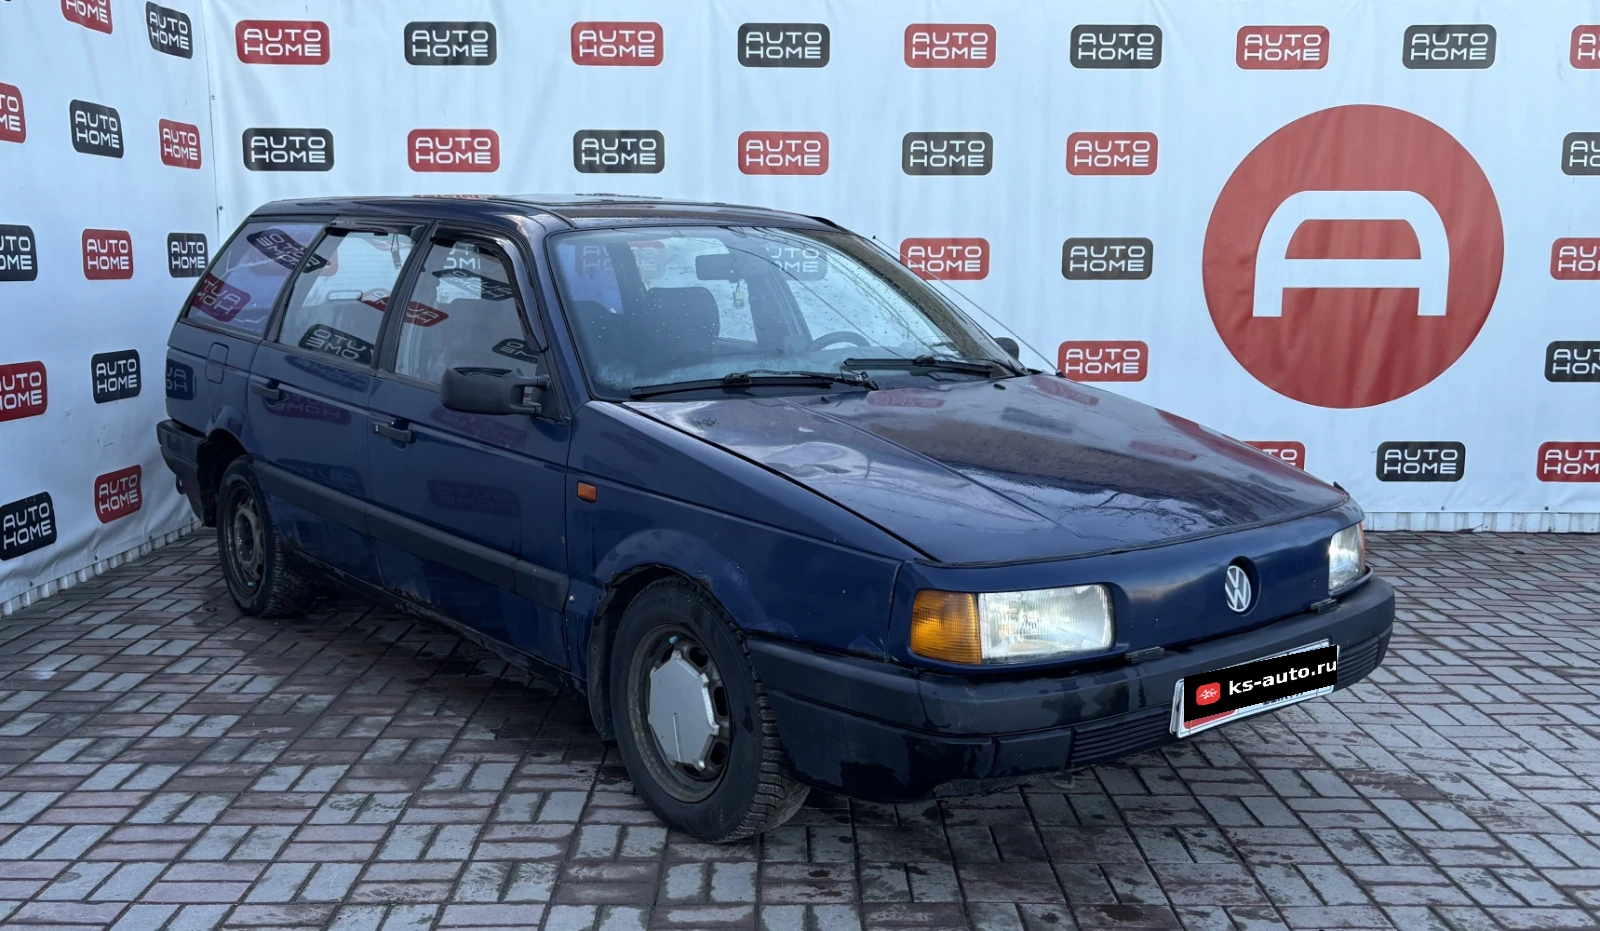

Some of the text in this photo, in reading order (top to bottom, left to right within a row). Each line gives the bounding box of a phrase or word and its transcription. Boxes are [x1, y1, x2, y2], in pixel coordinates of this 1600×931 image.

[66, 0, 109, 23] HOME
[149, 11, 188, 34] AUTO
[151, 29, 190, 50] HOME
[244, 29, 321, 42] AUTO
[412, 30, 489, 42] AUTO
[579, 30, 656, 42] AUTO
[746, 31, 822, 44] AUTO
[912, 32, 988, 44] AUTO
[1078, 33, 1154, 45] AUTO
[1245, 34, 1322, 46] AUTO
[1412, 33, 1488, 46] AUTO
[244, 44, 321, 57] HOME
[412, 44, 489, 57] HOME
[579, 45, 655, 57] HOME
[746, 46, 822, 59] HOME
[912, 47, 987, 59] HOME
[1078, 48, 1153, 60] HOME
[1244, 48, 1320, 61] HOME
[1410, 48, 1487, 60] HOME
[0, 94, 19, 112] TO
[0, 114, 21, 132] ME
[75, 110, 118, 131] AUTO
[76, 129, 120, 149] HOME
[163, 128, 197, 145] AUTO
[251, 136, 326, 149] AUTO
[415, 137, 491, 149] AUTO
[581, 138, 657, 151] AUTO
[746, 140, 821, 152] AUTO
[910, 141, 985, 153] AUTO
[1075, 140, 1150, 152] AUTO
[1570, 141, 1600, 152] AU
[164, 144, 198, 161] HOME
[251, 151, 326, 163] HOME
[415, 151, 491, 164] HOME
[581, 152, 656, 165] HOME
[746, 154, 820, 166] HOME
[910, 155, 984, 167] HOME
[1074, 155, 1149, 167] HOME
[1569, 155, 1600, 167] HO
[0, 235, 31, 251] TO
[87, 238, 129, 254] AUTO
[171, 241, 205, 254] AUTO
[767, 248, 819, 258] UTO
[908, 246, 982, 258] AUTO
[1070, 246, 1145, 258] AUTO
[1559, 246, 1600, 257] AU
[88, 256, 130, 270] HOME
[172, 257, 206, 269] HOME
[908, 260, 981, 272] HOME
[1069, 260, 1144, 272] HOME
[1558, 260, 1600, 271] HO
[1066, 349, 1140, 360] AUTO
[96, 358, 137, 376] AUTO
[1065, 362, 1139, 374] HOME
[0, 372, 42, 391] UTO
[97, 375, 137, 393] HOME
[0, 389, 42, 410] OME
[1262, 449, 1297, 460] TO
[1384, 449, 1458, 461] AUTO
[1545, 450, 1600, 461] AUT
[1383, 462, 1457, 475] HOME
[1544, 462, 1600, 475] HOM
[99, 473, 138, 498] AUTO
[100, 490, 139, 514] HOME
[3, 502, 50, 531] AUTO
[3, 519, 52, 551] HOME
